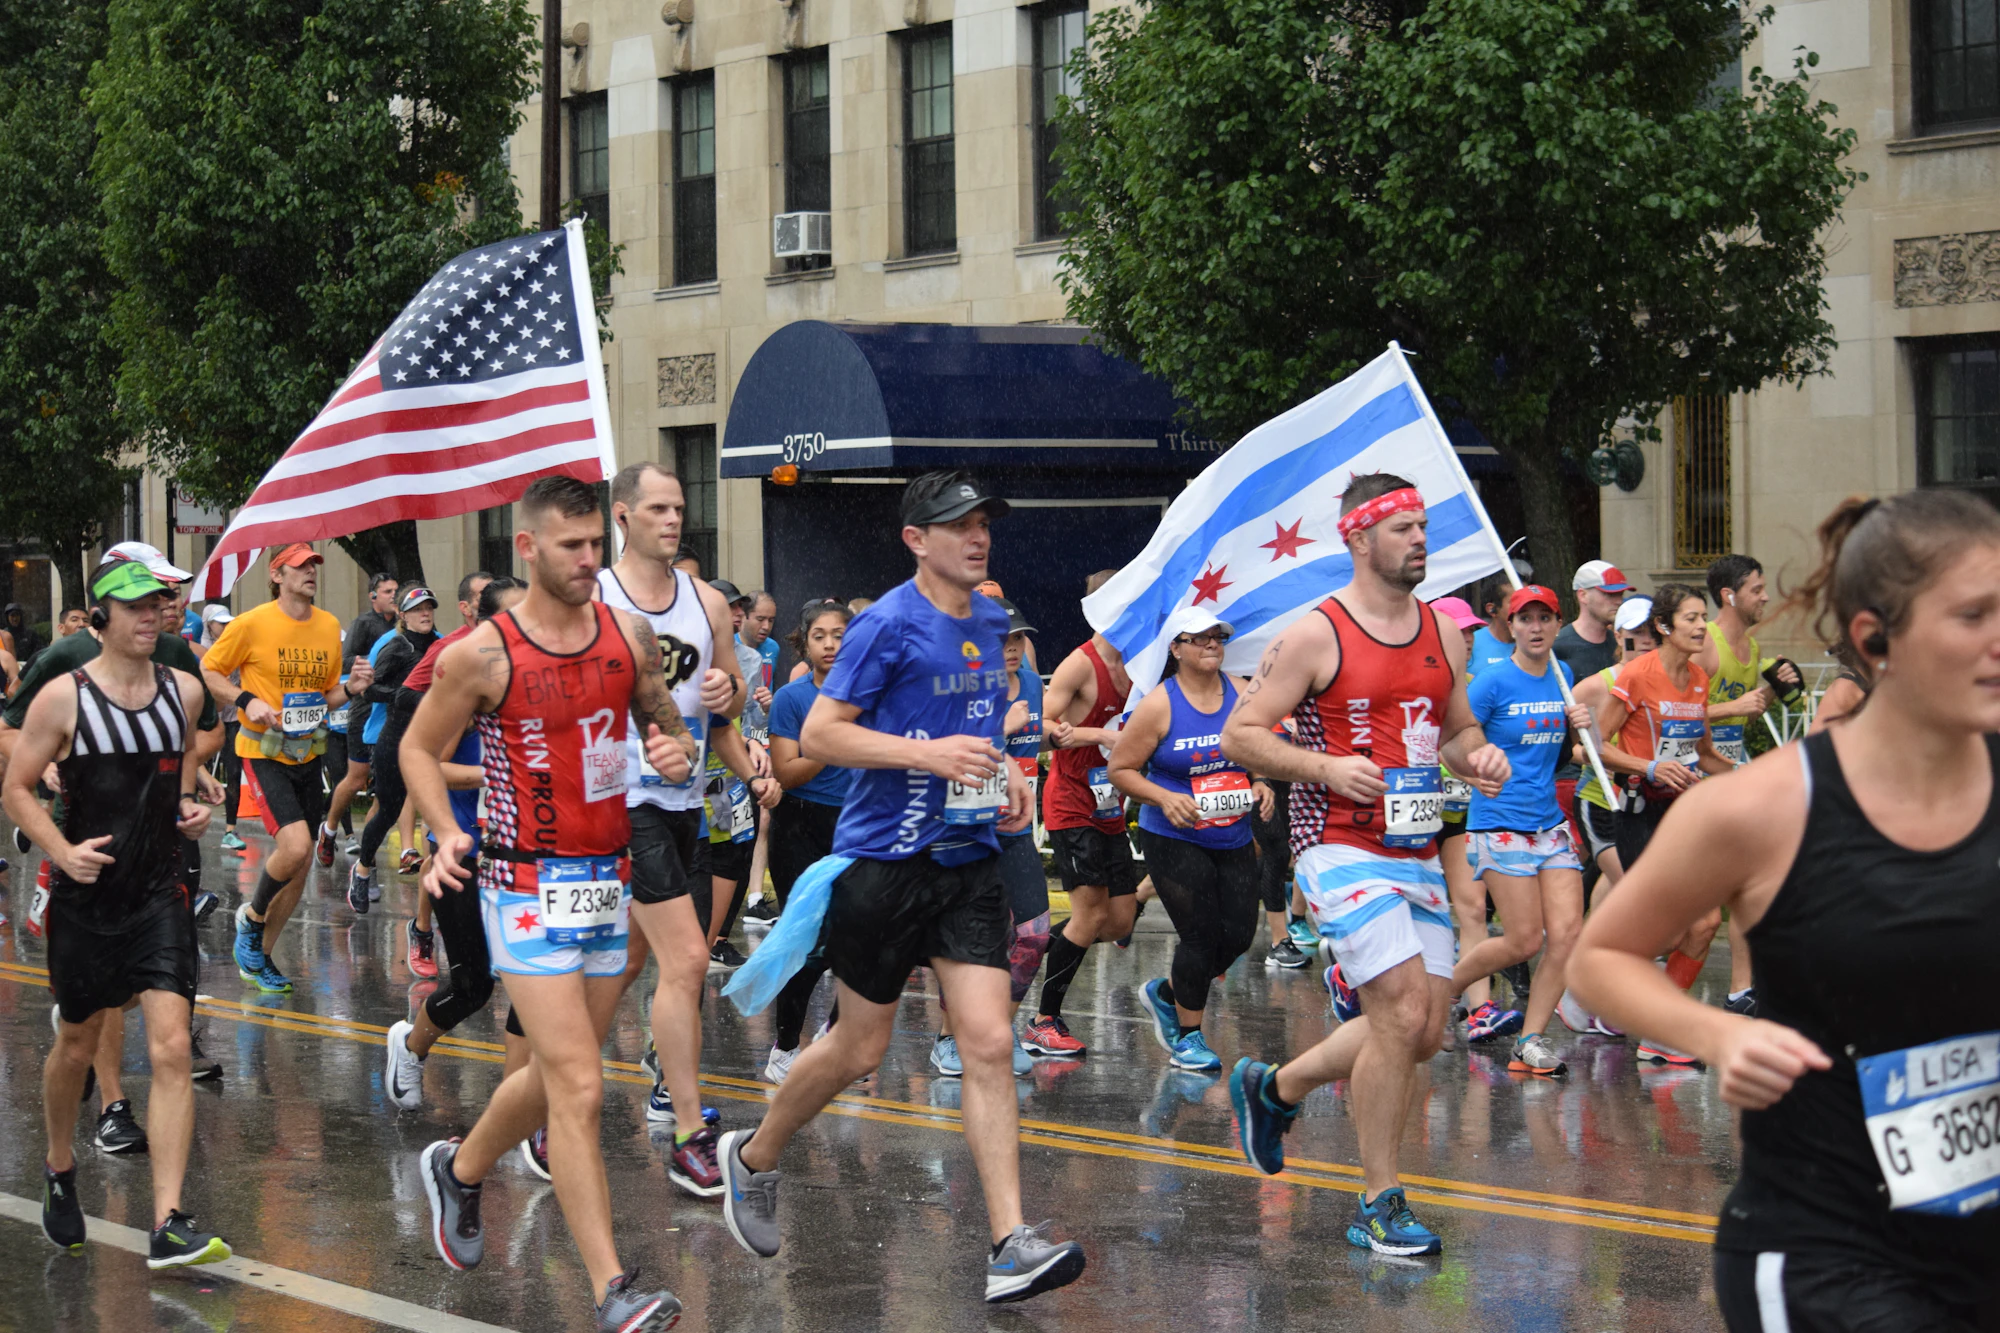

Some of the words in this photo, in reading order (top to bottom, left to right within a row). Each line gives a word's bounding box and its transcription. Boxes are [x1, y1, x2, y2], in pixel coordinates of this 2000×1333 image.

[784, 431, 825, 463] 3750
[1165, 430, 1226, 455] Thirty
[278, 648, 328, 661] MISSION
[279, 663, 299, 675] OUR
[305, 664, 328, 679] LADY
[523, 656, 604, 705] BRETT
[280, 678, 295, 688] THE
[933, 673, 980, 696] LUIS
[284, 711, 291, 725] G
[297, 708, 324, 724] 31851
[1347, 698, 1373, 745] RUN
[519, 718, 551, 769] RUN
[1173, 733, 1223, 751] STUD
[1520, 732, 1551, 745] RUN
[1658, 741, 1670, 756] F
[1188, 760, 1226, 775] RUN
[529, 771, 558, 853] PROU
[1200, 796, 1209, 813] C
[1214, 793, 1251, 812] 19014
[1391, 800, 1401, 823] F
[546, 889, 557, 914] F
[570, 886, 620, 914] 23346
[1922, 1046, 1984, 1088] LISA
[1884, 1125, 1915, 1177] G
[1932, 1094, 2000, 1163] 3682
